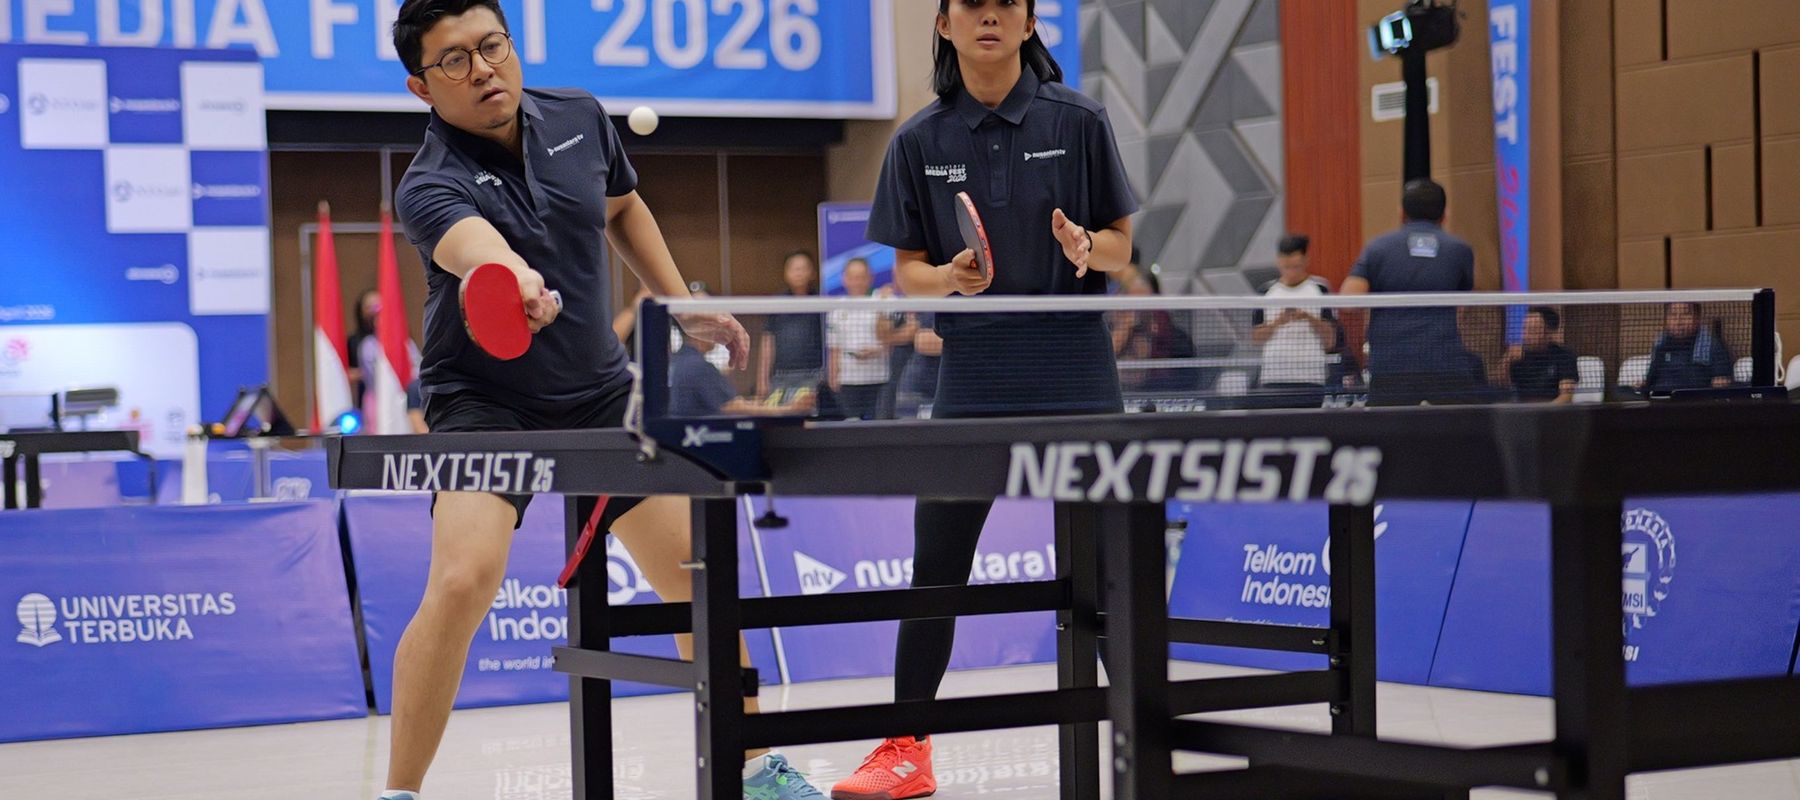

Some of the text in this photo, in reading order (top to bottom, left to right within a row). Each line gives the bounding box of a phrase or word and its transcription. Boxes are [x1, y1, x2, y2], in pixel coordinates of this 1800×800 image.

[0, 0, 280, 57] EDIA
[592, 0, 823, 71] 2026
[1490, 4, 1518, 145] FEST
[382, 453, 556, 493] NEXTSIST 25
[1005, 438, 1382, 505] NEXTSIST 25
[1243, 543, 1317, 575] Telkom
[803, 570, 833, 588] ntv
[61, 592, 236, 619] UNIVERSITAS
[64, 618, 194, 644] TERBUKA
[503, 656, 540, 670] world
